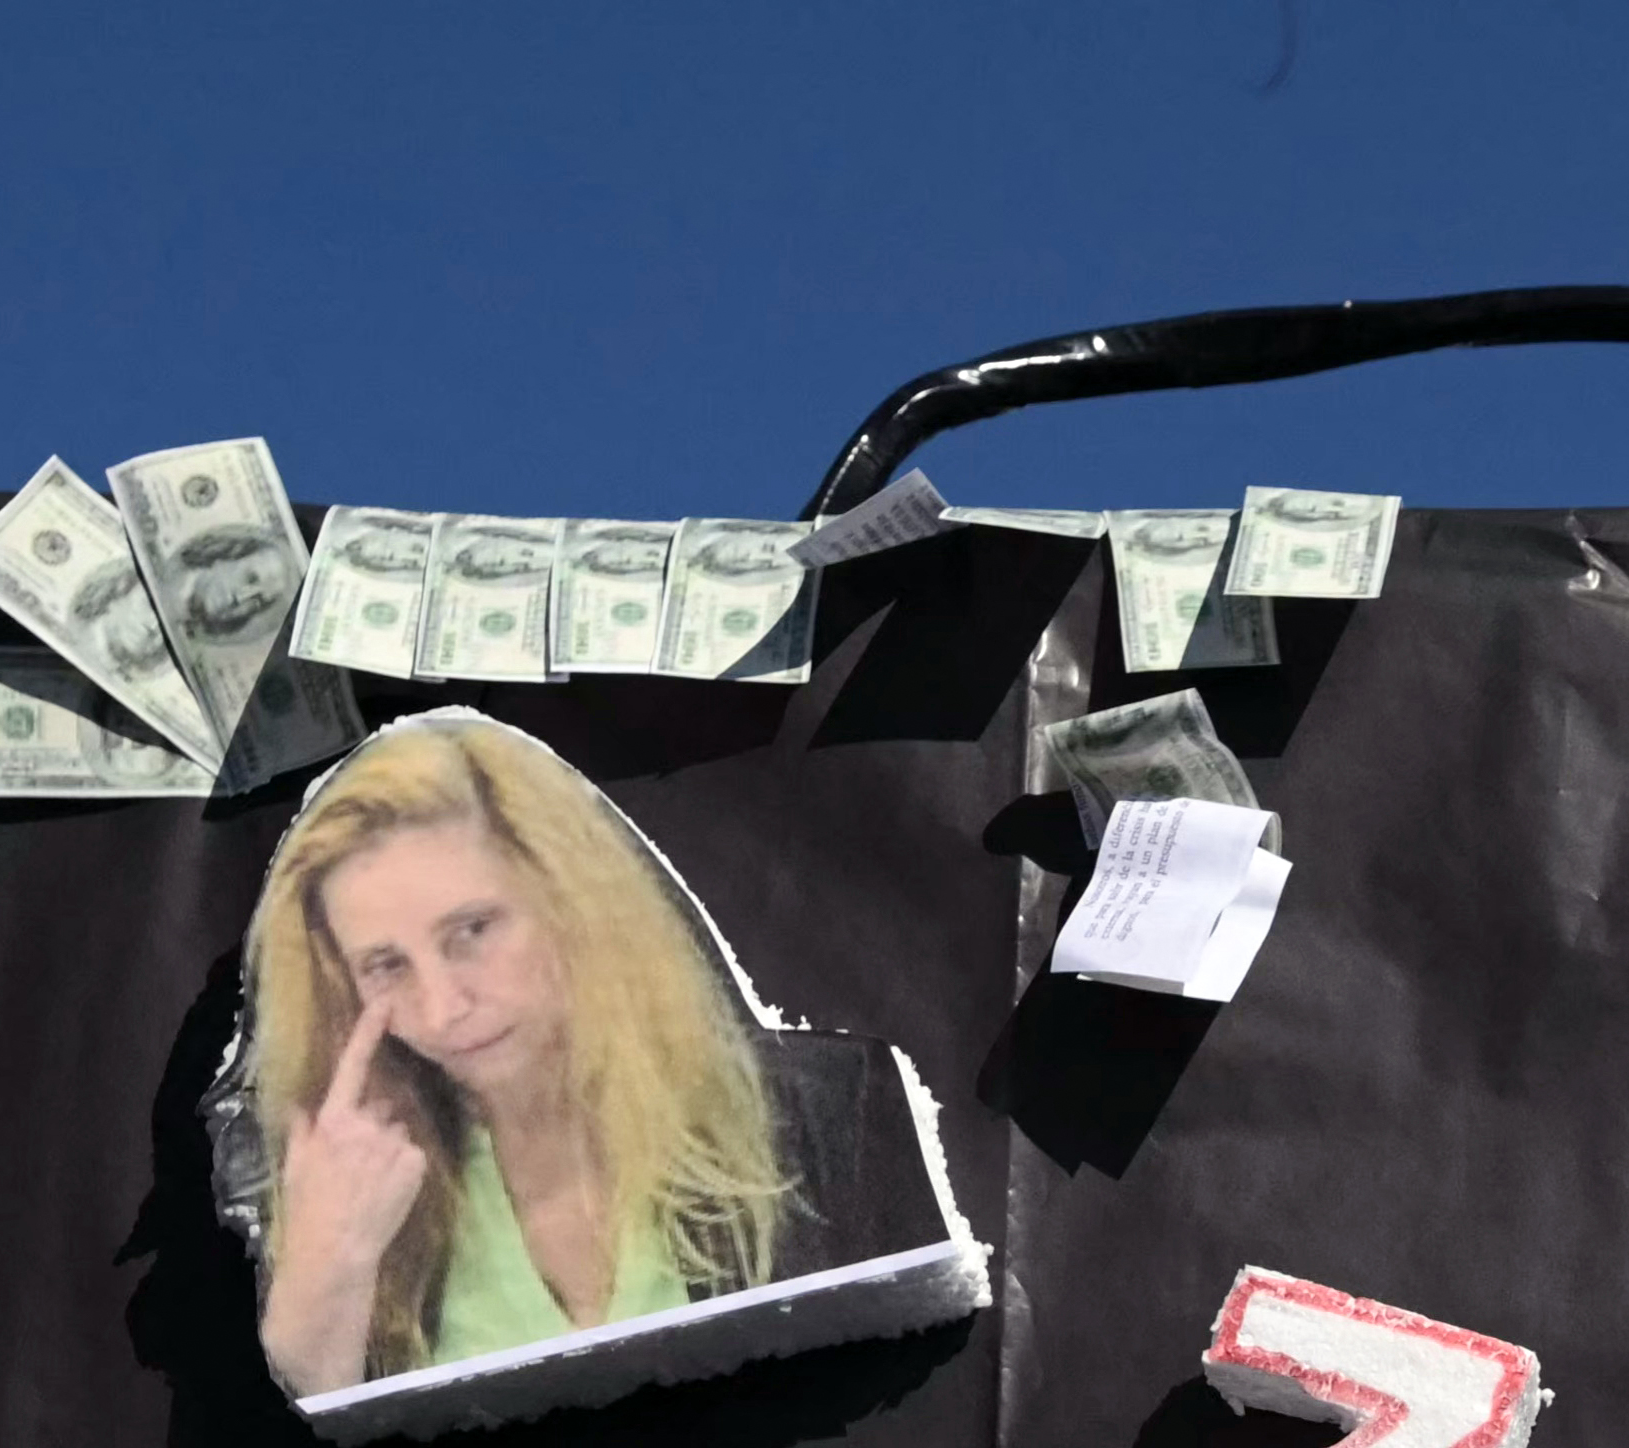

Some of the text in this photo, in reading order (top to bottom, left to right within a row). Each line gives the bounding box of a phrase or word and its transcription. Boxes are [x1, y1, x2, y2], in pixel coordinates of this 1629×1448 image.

[1129, 818, 1143, 846] crisis
[1146, 821, 1161, 845] plan
[1156, 811, 1183, 875] presupuesto
[1122, 850, 1135, 861] la
[1141, 850, 1152, 865] un
[1117, 865, 1130, 879] de
